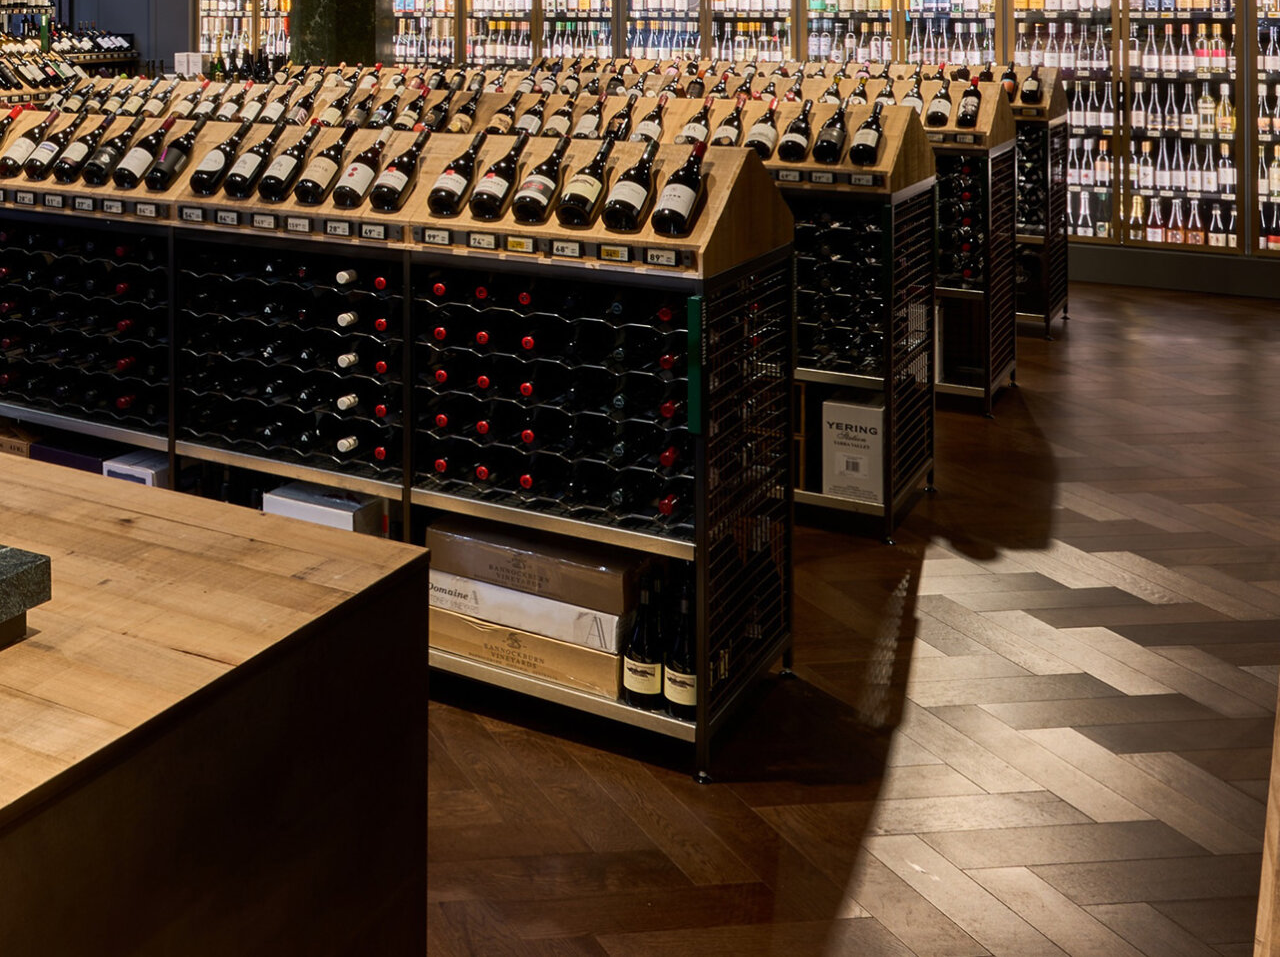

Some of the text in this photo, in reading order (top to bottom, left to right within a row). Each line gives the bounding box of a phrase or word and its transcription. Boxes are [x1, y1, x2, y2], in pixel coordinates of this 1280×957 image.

[826, 420, 878, 436] YERING
[483, 643, 544, 664] BANNOCKBURN
[491, 651, 537, 669] VINEYARDS
